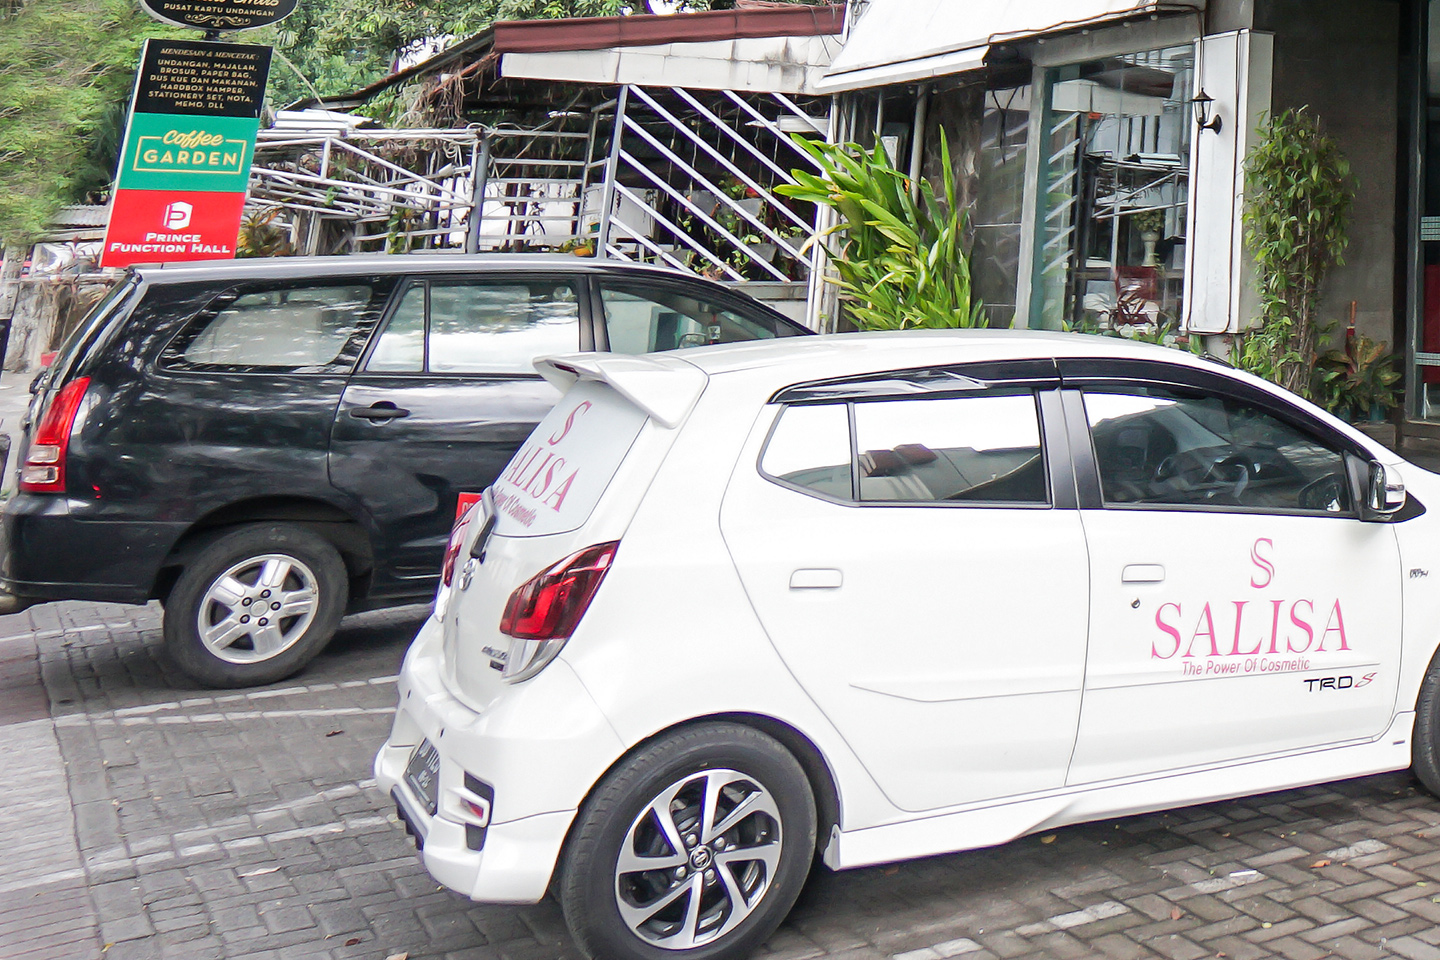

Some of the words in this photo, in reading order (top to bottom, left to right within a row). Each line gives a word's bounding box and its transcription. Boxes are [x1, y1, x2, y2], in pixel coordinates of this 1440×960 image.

[164, 3, 191, 11] PUSAT
[194, 5, 223, 13] KARTU
[225, 7, 275, 17] UNDANGAN
[150, 74, 168, 82] DUS
[201, 69, 229, 77] PAPER
[160, 83, 204, 92] HARDBOX
[148, 90, 204, 100] STATIONERY
[143, 149, 238, 166] GARDEN
[145, 233, 202, 243] PRINCE
[110, 243, 186, 253] FUNCTION
[191, 244, 231, 253] HALL
[502, 441, 580, 512] ALISA
[1250, 537, 1275, 589] S
[1151, 598, 1352, 660] SALISA
[1182, 661, 1203, 676] The
[1205, 660, 1241, 674] Power
[1244, 657, 1258, 673] Of
[1260, 656, 1310, 672] Cosmetic
[1304, 676, 1353, 692] TRD
